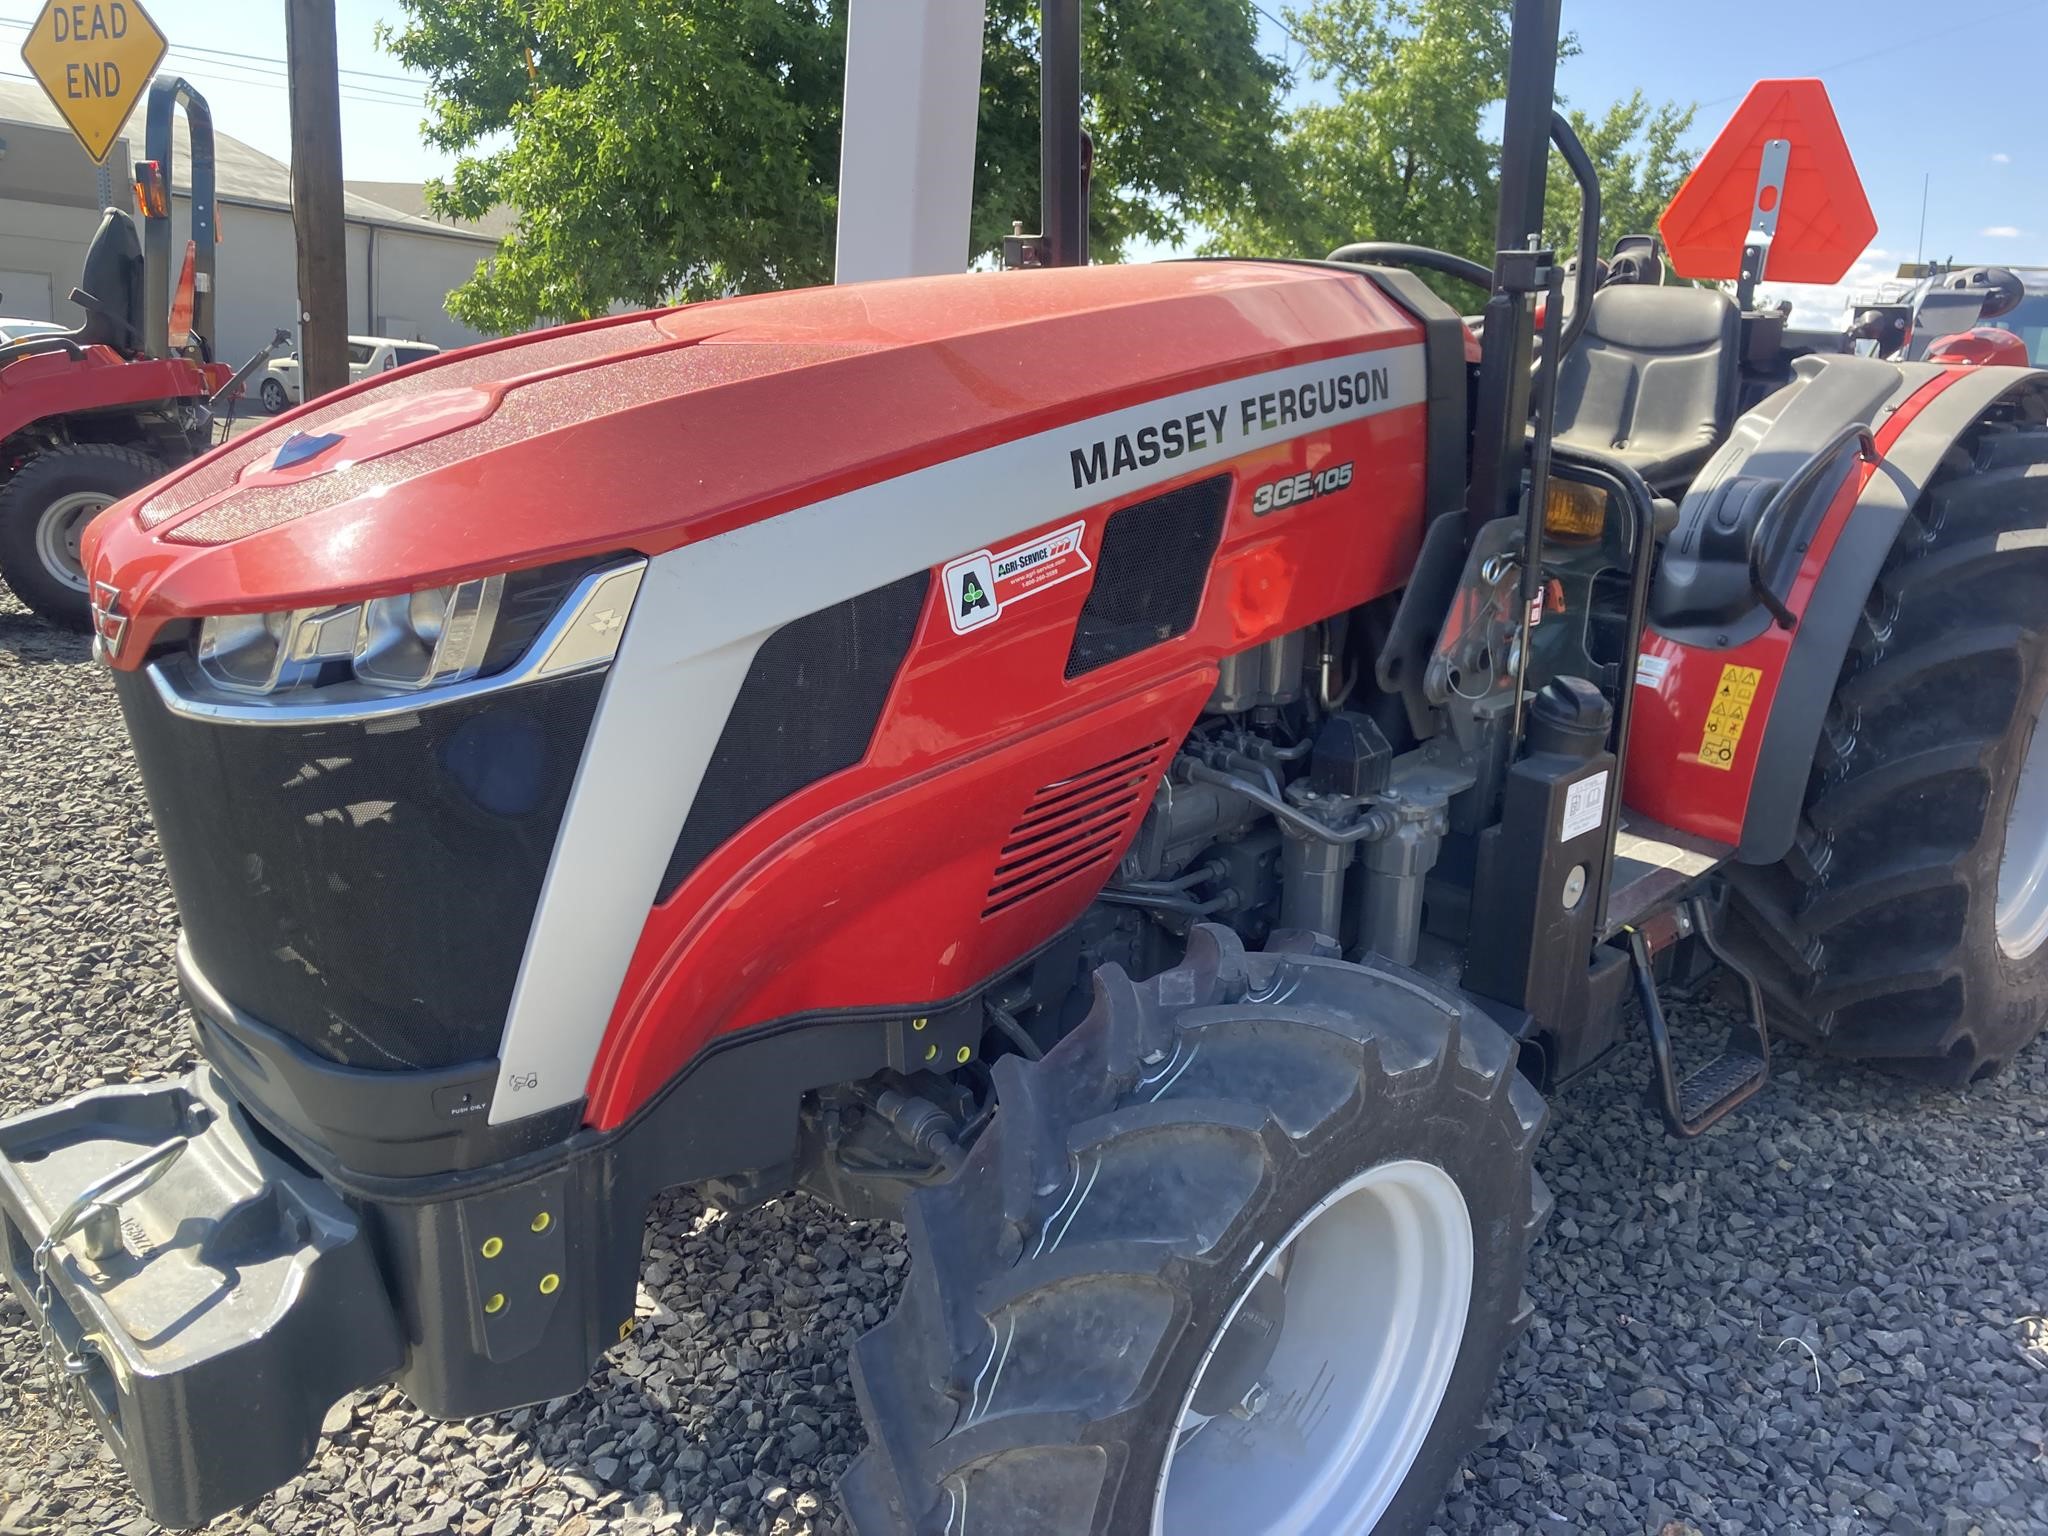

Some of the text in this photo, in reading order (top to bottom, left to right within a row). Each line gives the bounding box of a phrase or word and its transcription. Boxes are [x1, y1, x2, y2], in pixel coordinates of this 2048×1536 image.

[54, 3, 127, 42] DEAD
[66, 62, 121, 99] END
[1070, 367, 1389, 490] MASSEY FERGUSON
[961, 571, 991, 618] A
[451, 1103, 486, 1115] PUSH ONLY
